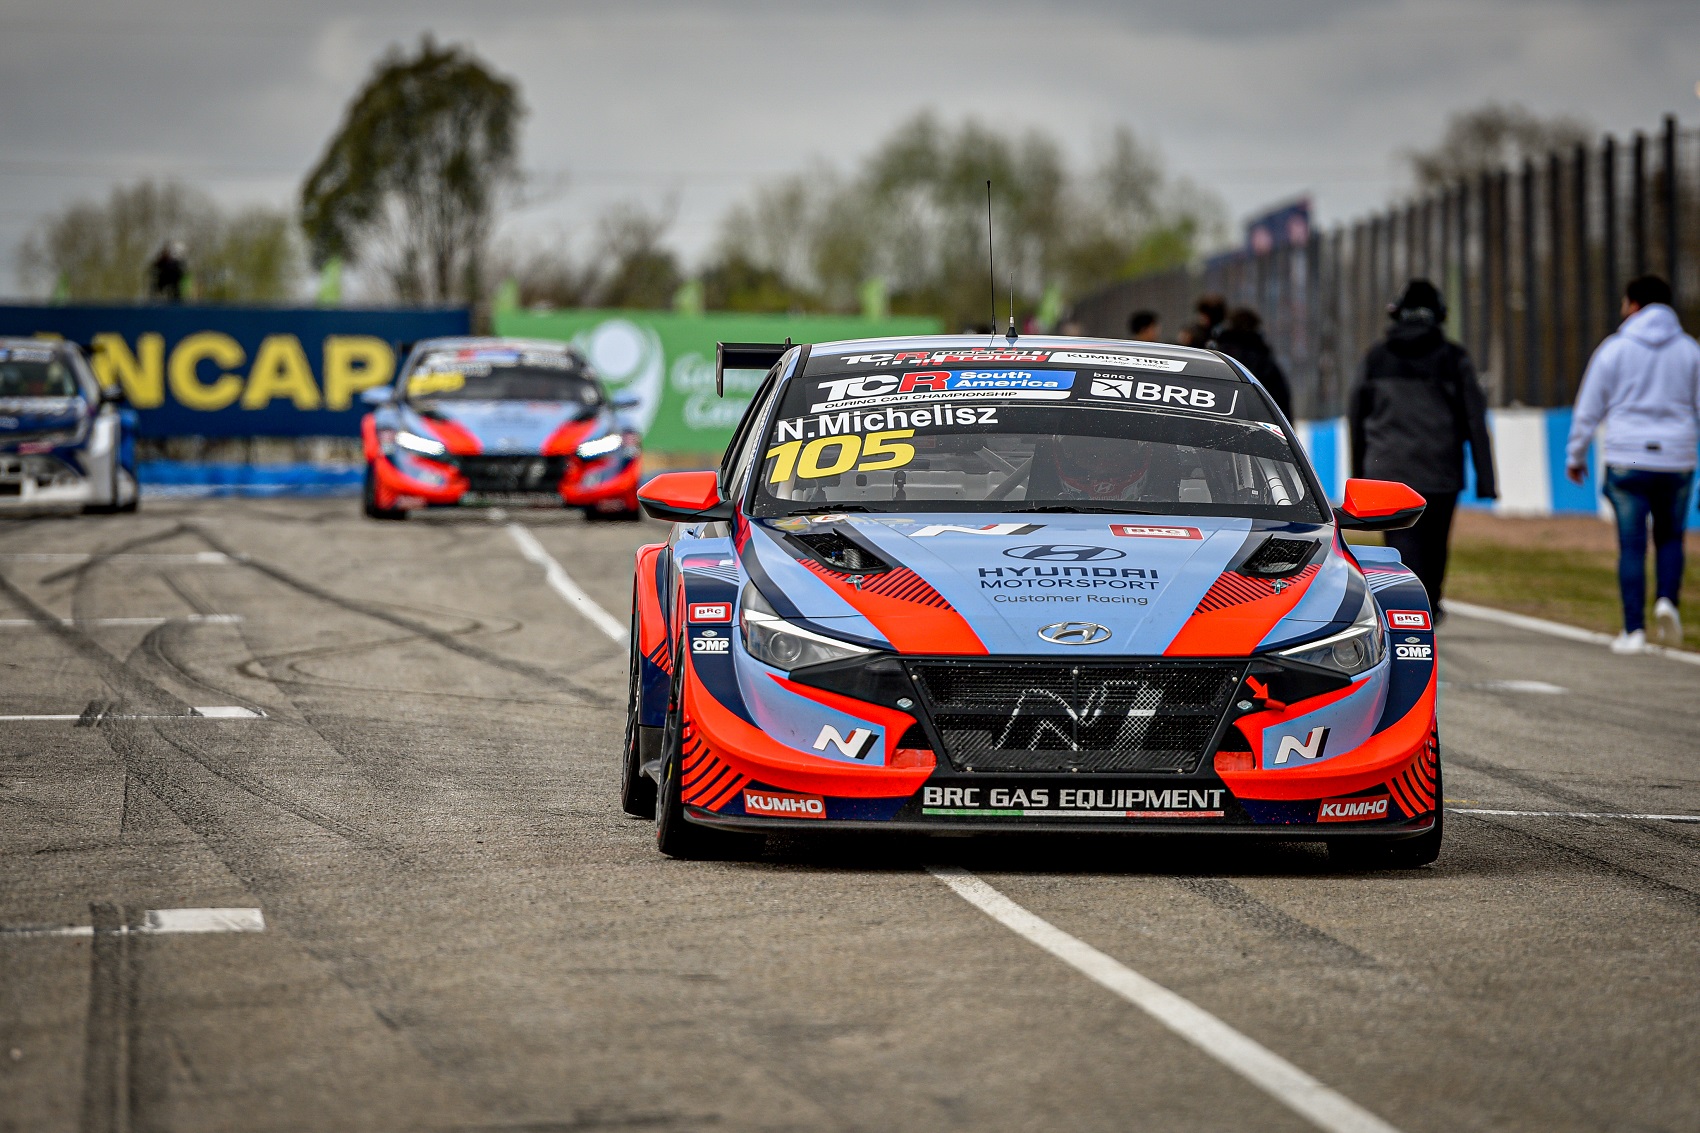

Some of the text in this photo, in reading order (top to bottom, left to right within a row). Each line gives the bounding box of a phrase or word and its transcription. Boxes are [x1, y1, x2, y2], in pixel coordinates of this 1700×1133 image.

[841, 351, 930, 364] TCR
[1067, 353, 1130, 361] KUMHO
[92, 331, 396, 411] NCAP
[960, 371, 1032, 380] South
[1093, 372, 1135, 380] banco
[817, 370, 951, 401] TCR
[954, 380, 1059, 388] America
[913, 391, 1017, 400] CHAMPIONSHIP
[1135, 381, 1216, 408] BRB
[777, 403, 999, 442] N.Michelisz
[766, 429, 916, 484] 105
[978, 566, 1159, 579] HYUNDAI
[981, 579, 1159, 590] MOTORSPORT
[994, 594, 1148, 605] Customer Racing
[692, 640, 729, 651] OMP
[1395, 646, 1431, 657] OMP
[746, 795, 823, 813] KUMHO
[923, 786, 1225, 809] BRC GAS EQUIPMENT
[1320, 799, 1388, 817] KUMHO
